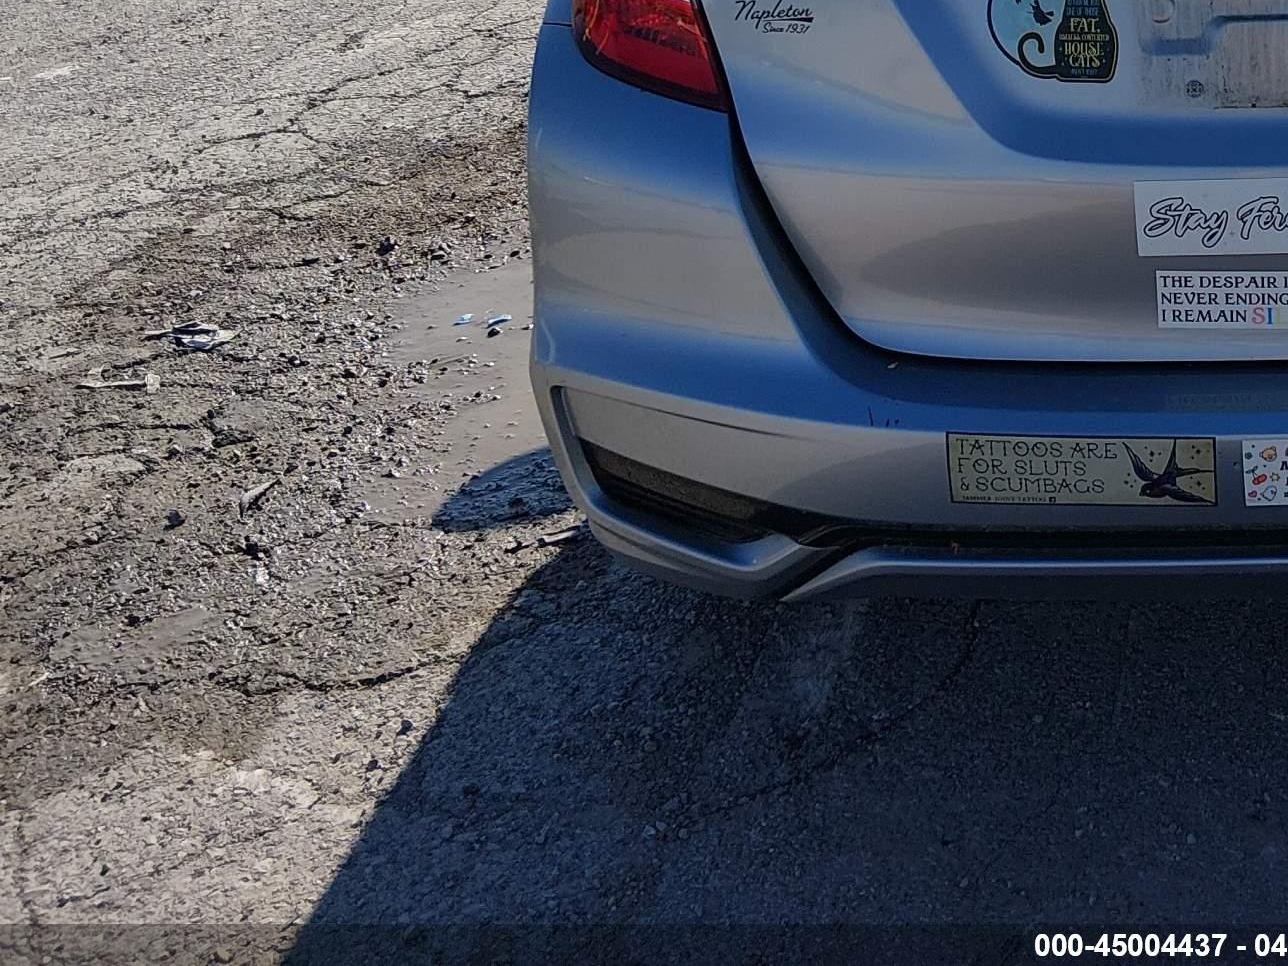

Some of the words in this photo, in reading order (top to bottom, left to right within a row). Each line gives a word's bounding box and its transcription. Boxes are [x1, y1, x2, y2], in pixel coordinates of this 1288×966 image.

[762, 21, 785, 34] Since
[1064, 41, 1105, 56] HOUSE
[1069, 54, 1101, 68] CATS
[1144, 197, 1229, 248] Stay
[1160, 275, 1194, 288] THE
[1199, 275, 1277, 289] DESPAIR
[1161, 292, 1219, 306] NEVER
[1161, 309, 1167, 322] I
[1172, 308, 1248, 323] REMAIN
[956, 438, 1063, 458] TATTOOS
[1070, 442, 1118, 460] ARE
[957, 457, 1007, 475] FOR
[1013, 459, 1087, 477] SLUTS
[960, 476, 970, 491] &
[975, 476, 1105, 494] SCUMBAGS
